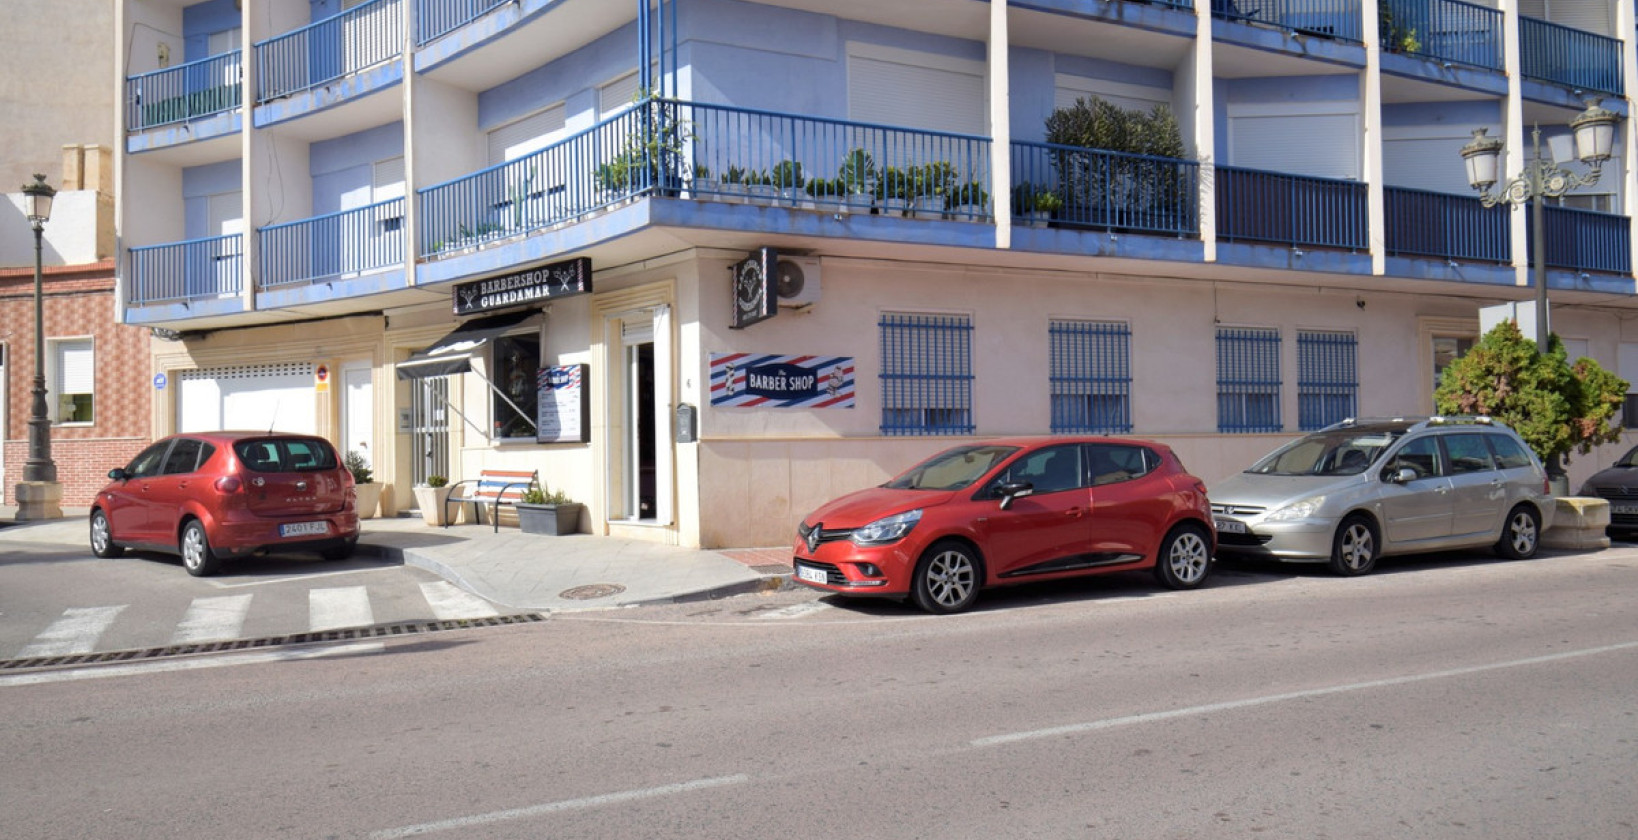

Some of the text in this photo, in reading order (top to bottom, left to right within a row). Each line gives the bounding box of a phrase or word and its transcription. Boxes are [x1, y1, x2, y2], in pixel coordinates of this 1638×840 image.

[481, 269, 550, 295] BARBERSHOP
[481, 285, 550, 308] GUARDAMAR
[750, 373, 814, 391] BARBER SHOP
